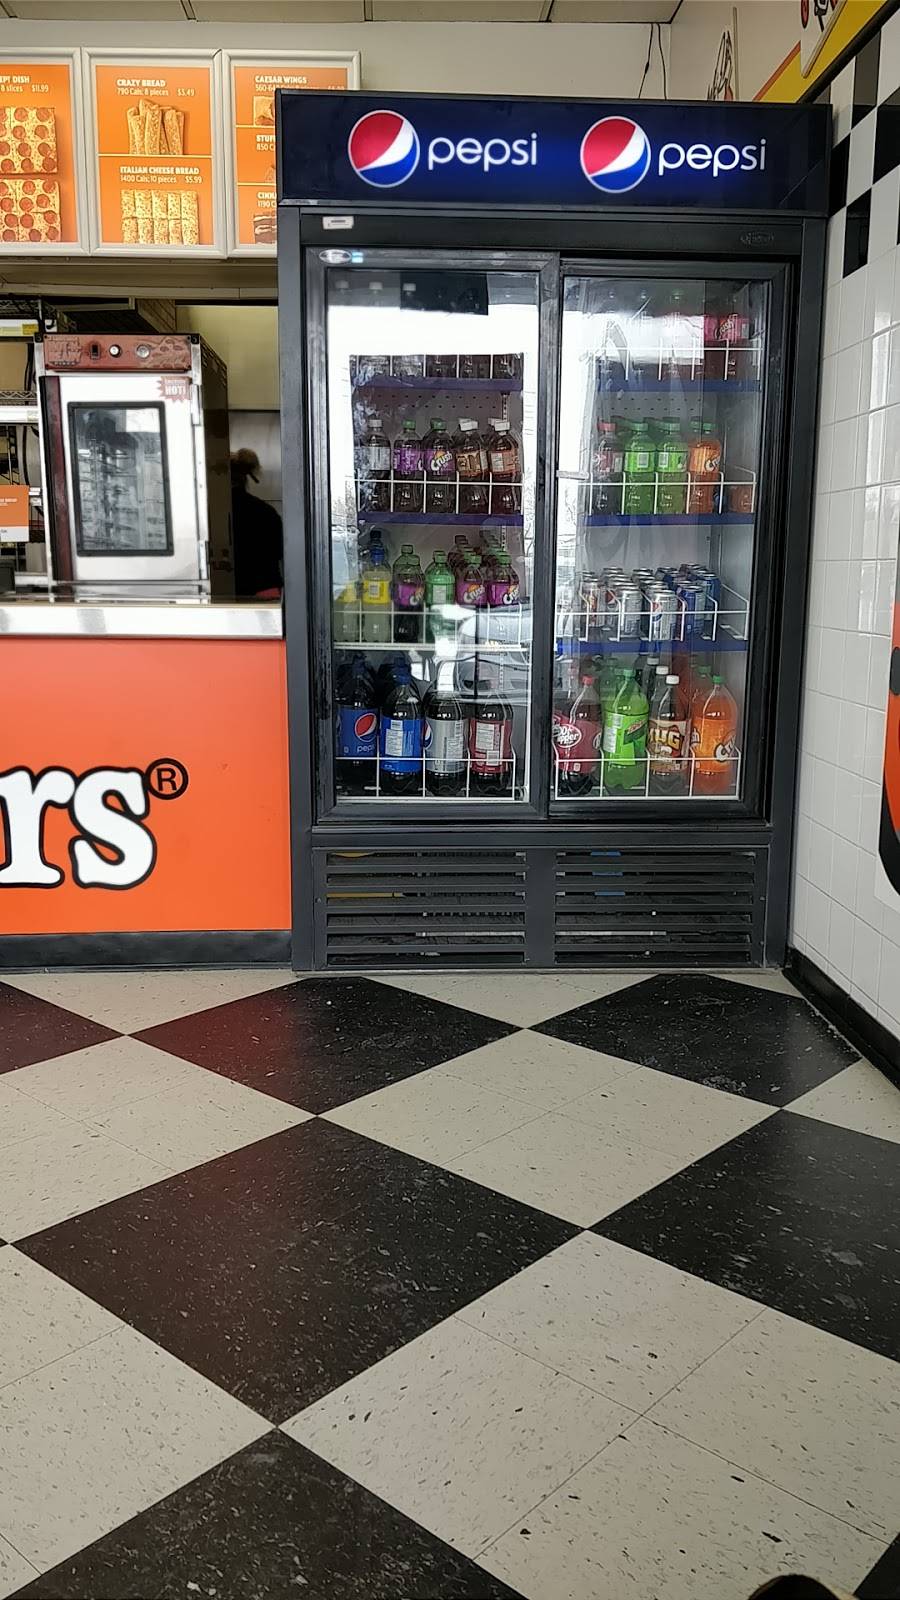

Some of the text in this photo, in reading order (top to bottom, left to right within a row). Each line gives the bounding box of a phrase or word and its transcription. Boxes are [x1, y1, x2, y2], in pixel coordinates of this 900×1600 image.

[12, 75, 30, 84] DISH
[116, 79, 166, 87] CRAZY BREAD
[254, 75, 307, 84] CAESAR WINGS
[6, 84, 24, 92] slices
[31, 84, 49, 93] $11.99
[117, 87, 130, 96] 790
[149, 88, 169, 97] pieces
[428, 132, 538, 172] pepsi
[658, 138, 766, 178] pepsi
[120, 166, 148, 174] ITALIAN
[175, 167, 200, 175] BREAD
[120, 174, 136, 182] 1400
[150, 175, 157, 183] 10
[157, 175, 177, 184] pieces
[430, 450, 454, 471] Crush
[463, 584, 486, 604] Crush
[356, 744, 376, 753] pep
